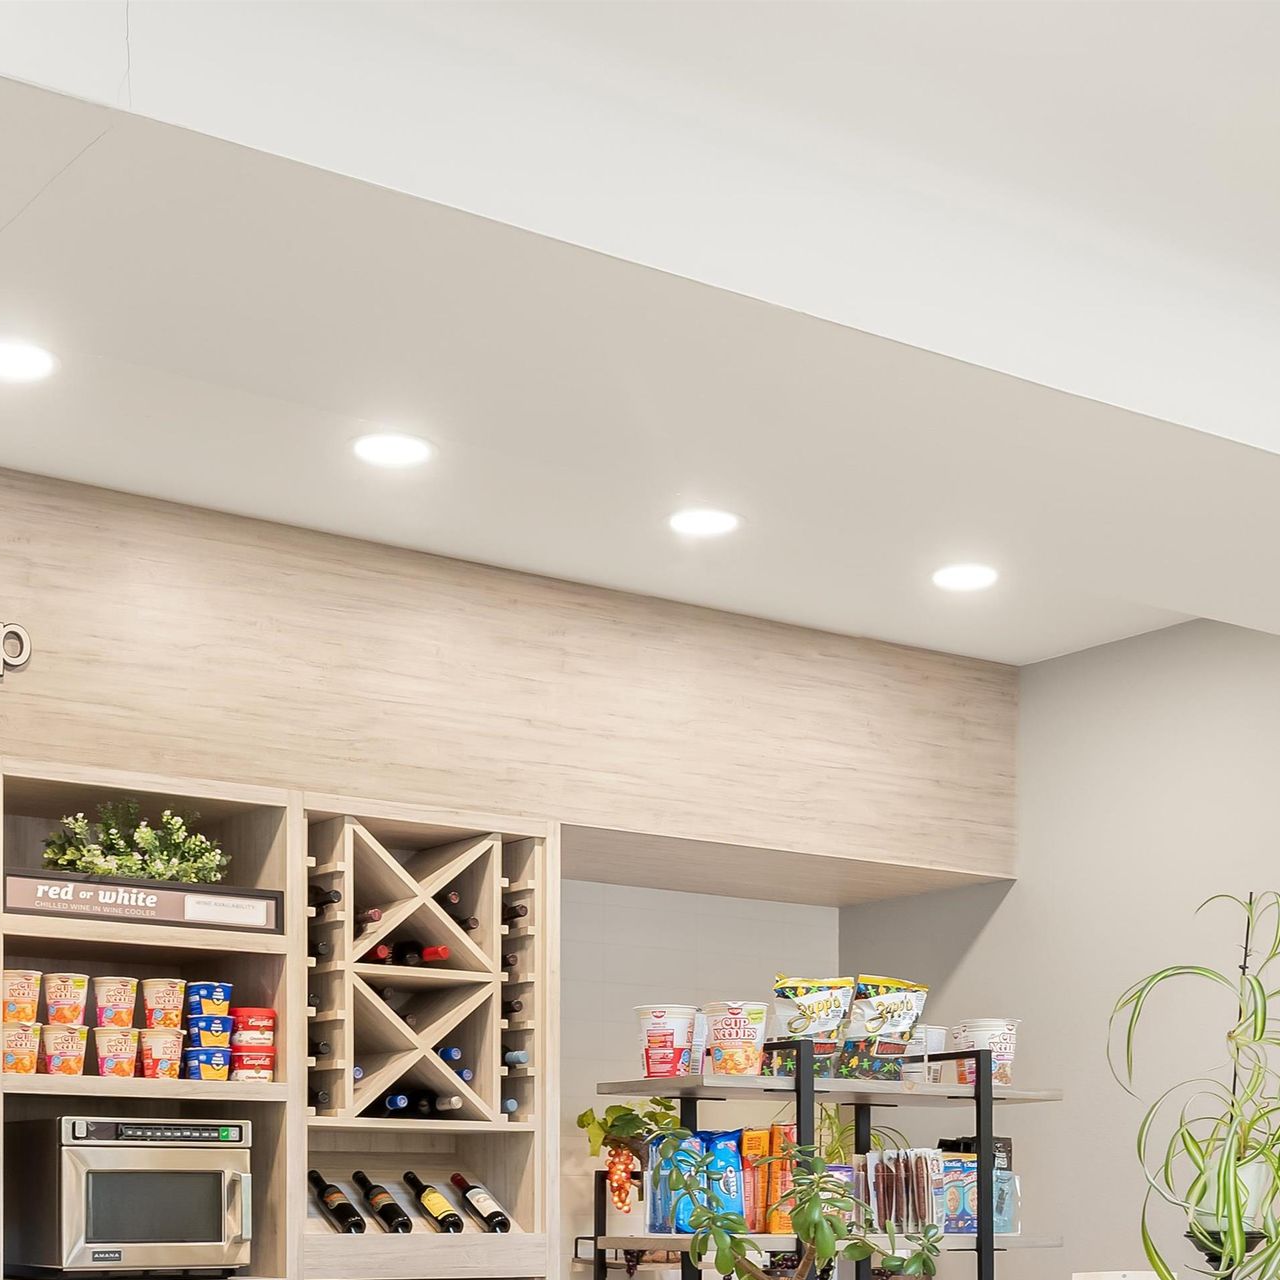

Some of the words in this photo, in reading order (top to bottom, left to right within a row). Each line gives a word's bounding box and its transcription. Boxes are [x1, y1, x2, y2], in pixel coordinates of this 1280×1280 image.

[36, 883, 74, 900] red
[79, 890, 94, 900] or
[98, 887, 158, 908] white
[34, 901, 68, 910] CHILLED
[70, 903, 91, 912] WINE
[102, 906, 123, 914] WINE
[125, 908, 156, 917] COOLER
[722, 1018, 749, 1028] CUP
[714, 1028, 757, 1040] NOODLES
[726, 1166, 737, 1198] OREO
